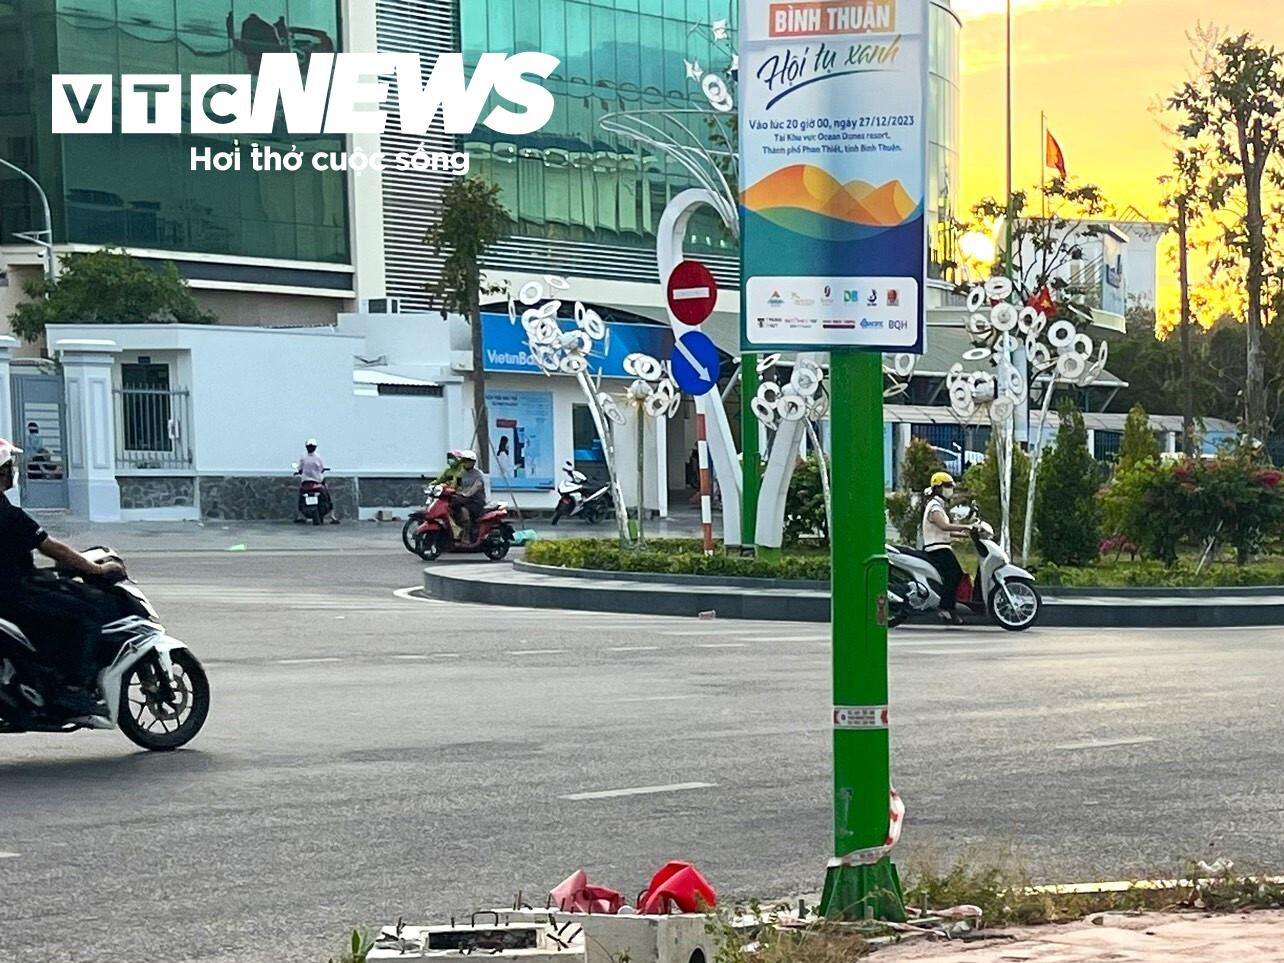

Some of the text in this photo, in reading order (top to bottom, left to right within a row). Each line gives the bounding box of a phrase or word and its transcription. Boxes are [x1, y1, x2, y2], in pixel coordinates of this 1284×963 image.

[774, 2, 890, 34] BÌNH THUẬN
[756, 34, 902, 91] Hội tụ xanh
[749, 115, 915, 131] Vào lúc 20 giờ 00, ngày 27/12/2023
[774, 133, 786, 142] Tại
[787, 133, 801, 141] Khu
[818, 132, 841, 141] Ocean
[762, 145, 785, 154] Thành
[787, 144, 801, 156] phố
[802, 145, 821, 153] Phan
[487, 349, 537, 366] VietinBa
